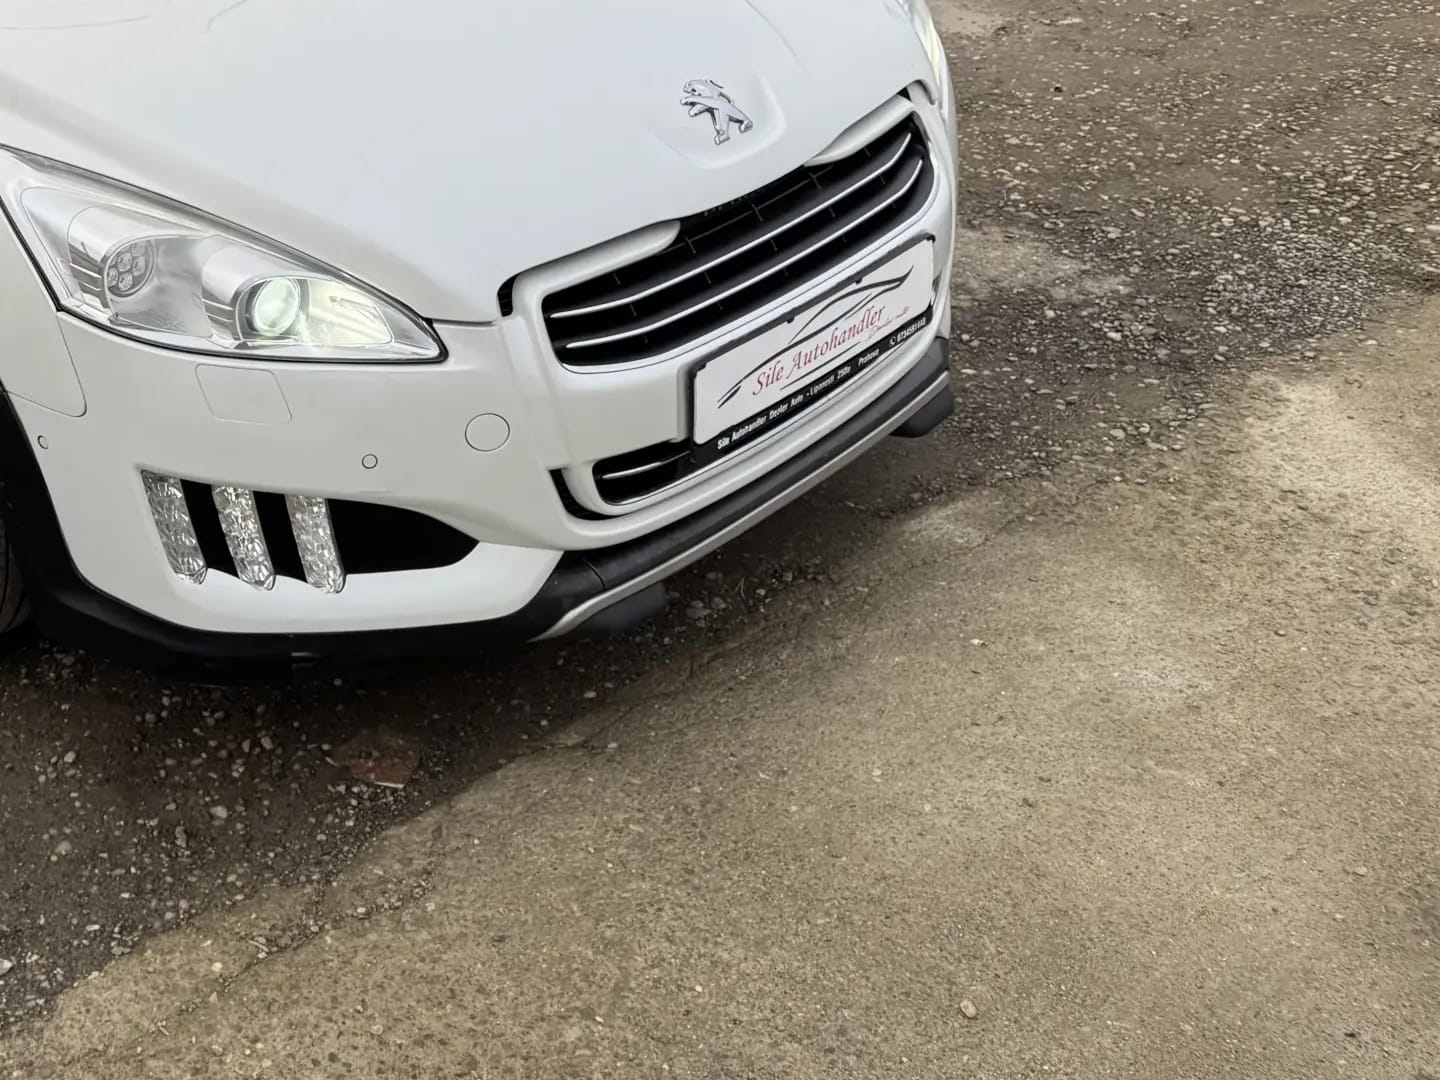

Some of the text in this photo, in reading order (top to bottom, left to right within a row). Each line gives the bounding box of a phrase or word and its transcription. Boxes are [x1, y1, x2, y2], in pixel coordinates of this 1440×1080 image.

[752, 360, 785, 395] Sile
[786, 305, 885, 379] Autohandler
[717, 437, 730, 450] Sile
[791, 394, 804, 407] Auto
